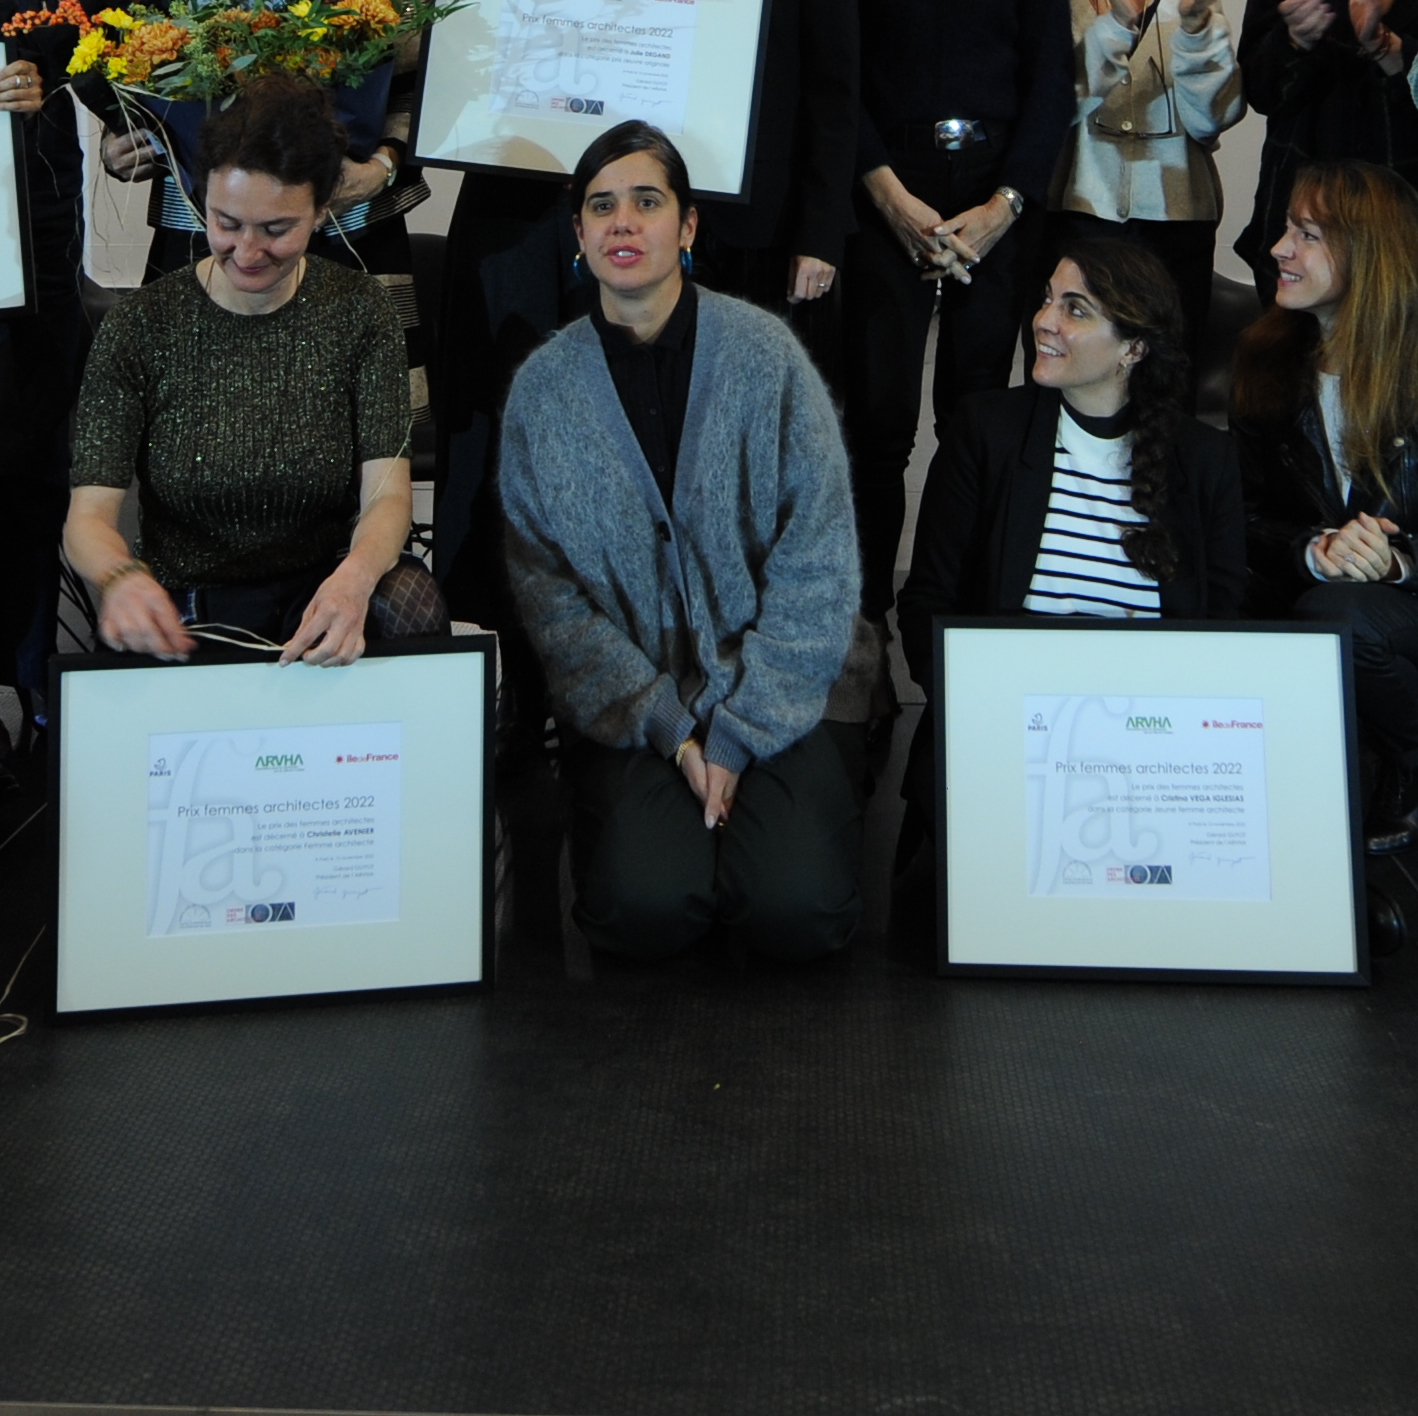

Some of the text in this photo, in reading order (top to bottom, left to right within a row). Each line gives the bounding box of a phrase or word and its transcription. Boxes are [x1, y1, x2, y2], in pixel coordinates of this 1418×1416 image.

[522, 13, 673, 38] Prix femmes architectes 2022
[1126, 717, 1172, 728] ARVHA
[255, 754, 303, 768] ARVHA
[1056, 762, 1242, 774] Prix femmes architectes 2022
[178, 796, 375, 817] Prix femmes architectes 2022
[300, 819, 330, 827] femmes
[332, 817, 374, 825] architectes
[265, 843, 301, 852] catégorie
[335, 839, 374, 847] architecte
